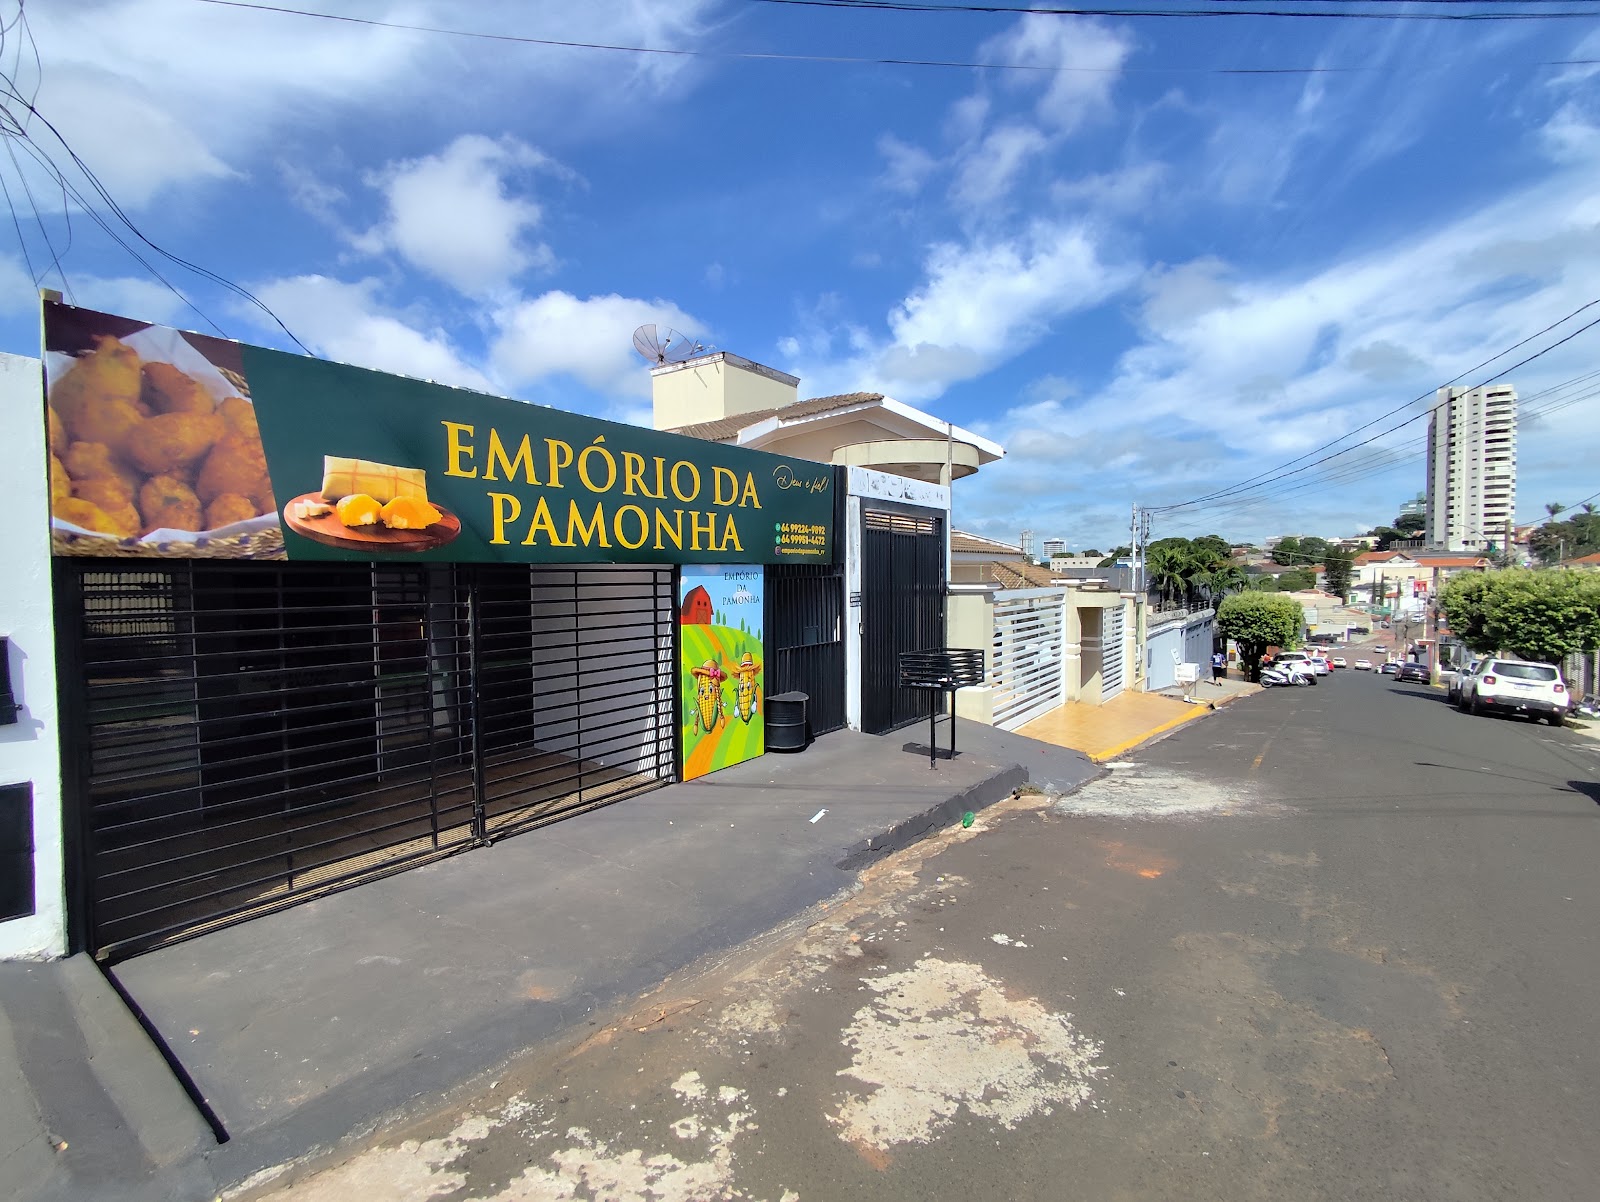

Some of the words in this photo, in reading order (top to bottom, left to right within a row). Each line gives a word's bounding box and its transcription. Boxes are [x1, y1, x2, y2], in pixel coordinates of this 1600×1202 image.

[441, 420, 701, 503] EMPÓRIO
[711, 466, 763, 509] DA
[487, 492, 744, 552] PAMONHA
[781, 523, 790, 532] 64
[781, 534, 790, 544] 64
[724, 570, 759, 581] EMPÓRIO
[736, 584, 747, 593] DA
[722, 595, 760, 606] PAMONHA
